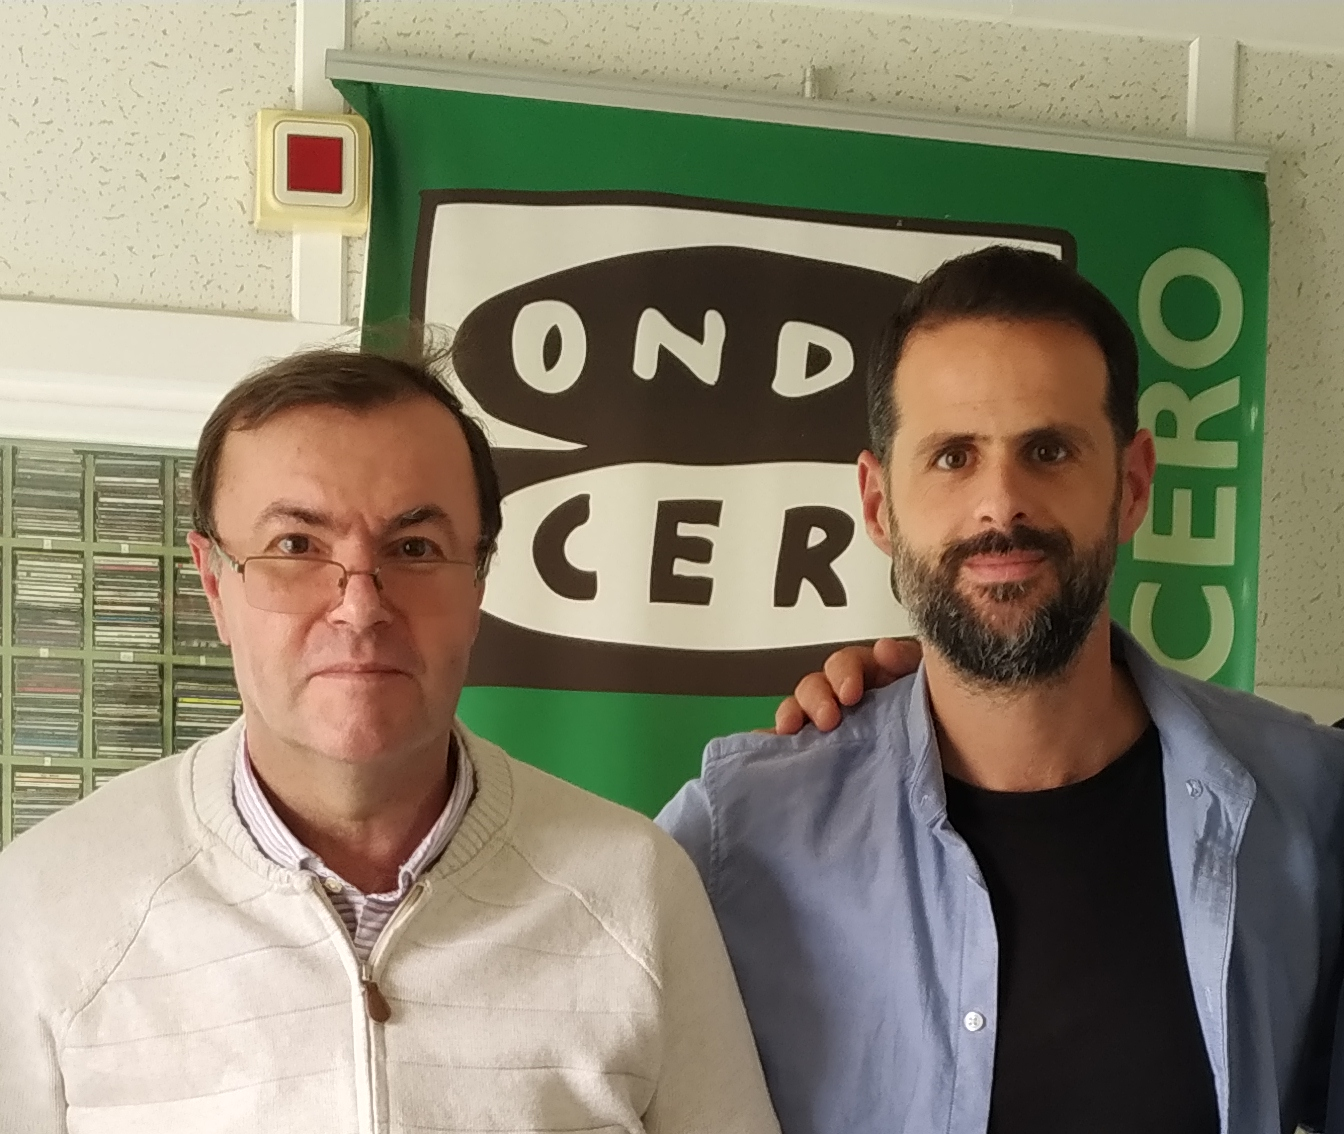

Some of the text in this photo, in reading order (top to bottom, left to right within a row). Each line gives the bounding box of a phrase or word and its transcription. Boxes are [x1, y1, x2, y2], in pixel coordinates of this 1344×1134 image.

[512, 301, 855, 397] OND
[1131, 247, 1244, 682] CERO
[532, 493, 856, 606] CER
